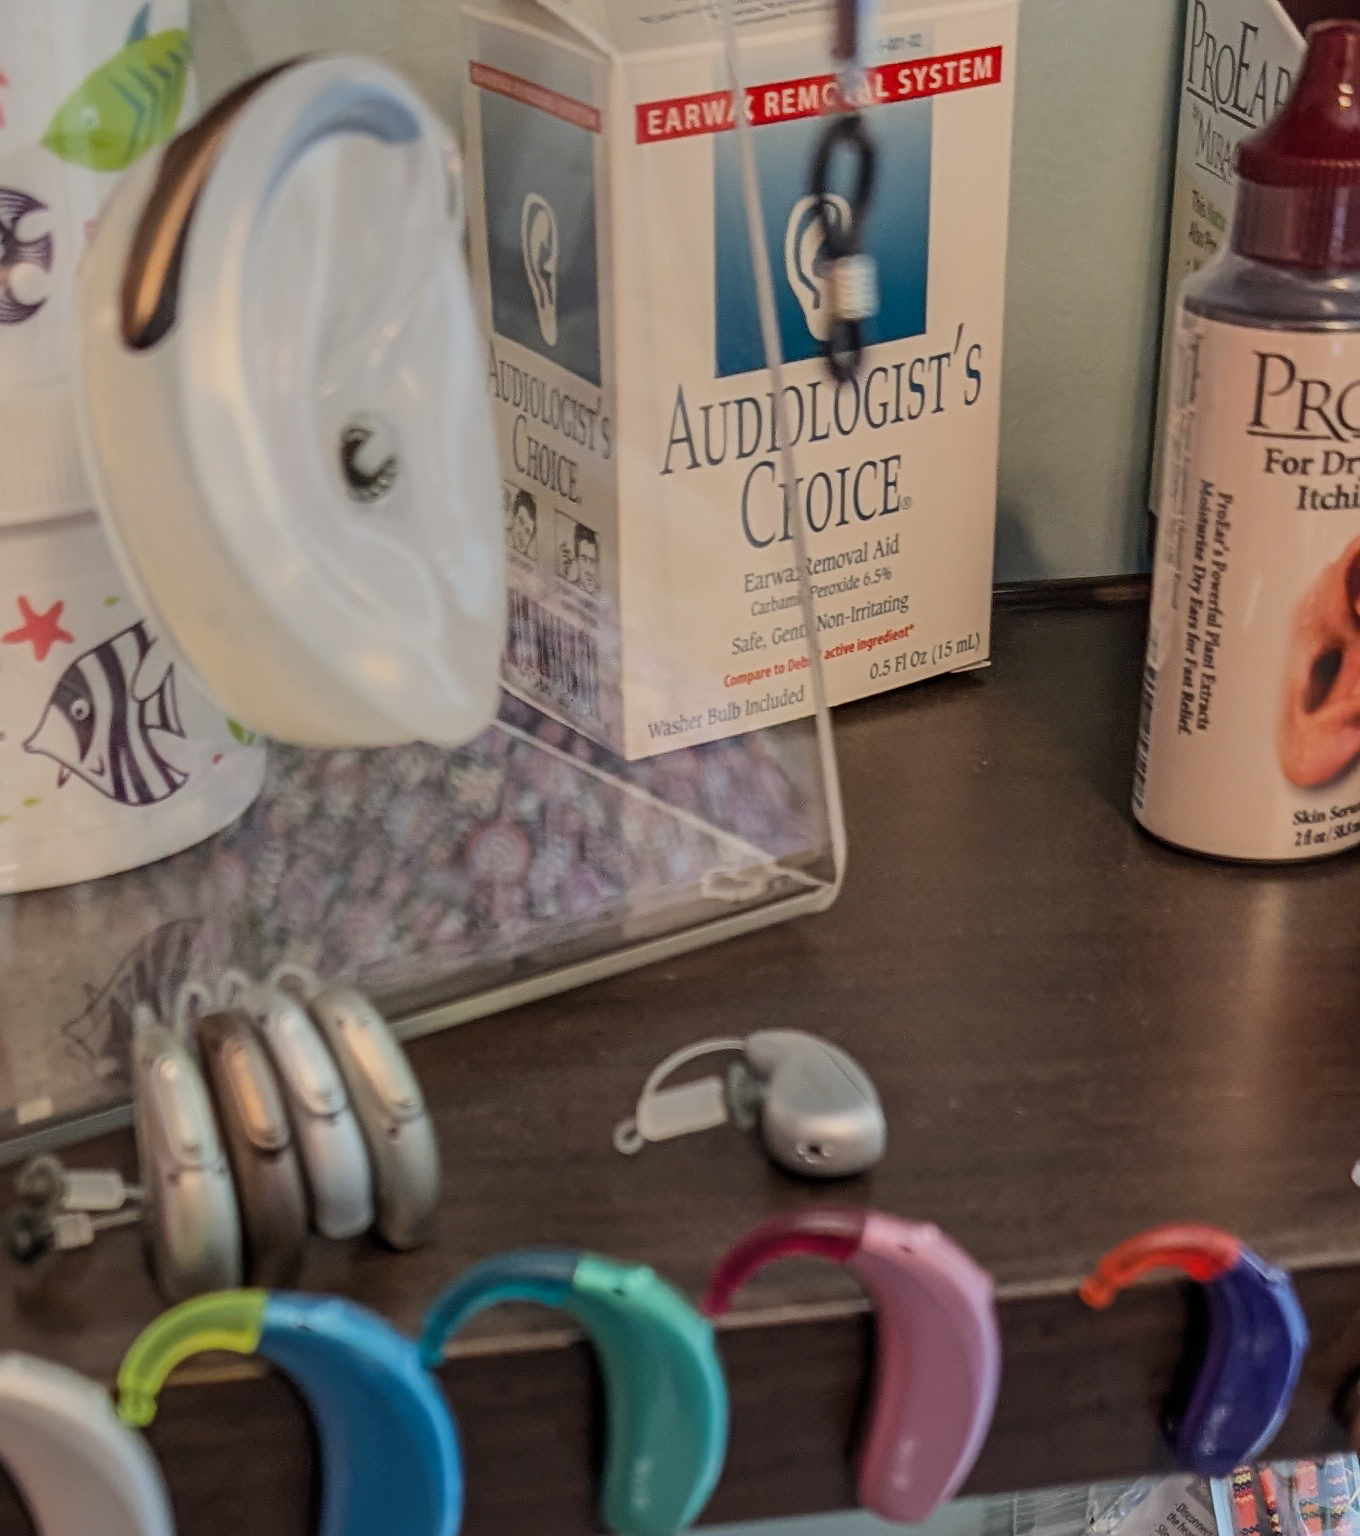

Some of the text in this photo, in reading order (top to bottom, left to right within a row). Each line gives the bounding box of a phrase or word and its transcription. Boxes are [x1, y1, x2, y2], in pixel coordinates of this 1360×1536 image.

[897, 55, 994, 95] SYSTEM
[1264, 447, 1314, 475] For
[873, 533, 900, 560] Aid
[863, 566, 893, 587] 6.5%
[732, 595, 910, 656] Safe, Non-Irritating
[724, 642, 855, 689] Compare active
[870, 632, 981, 680] 0.5 Oz (15 mL)
[648, 685, 805, 739] Washer Bulb Included
